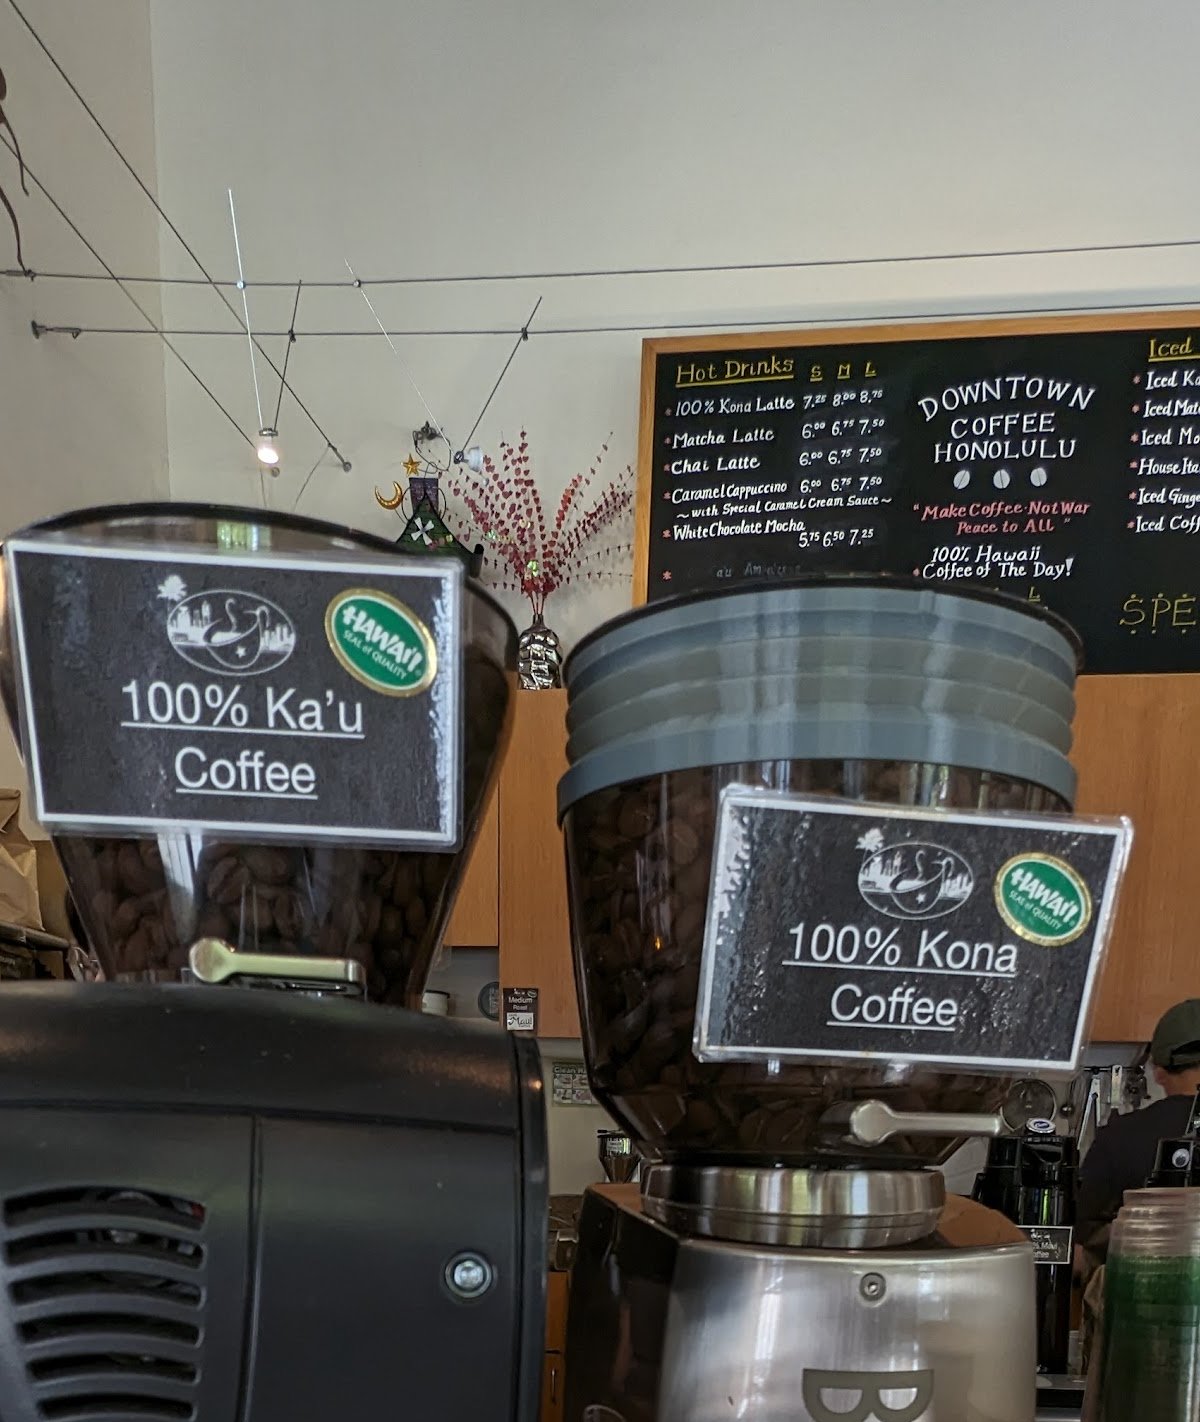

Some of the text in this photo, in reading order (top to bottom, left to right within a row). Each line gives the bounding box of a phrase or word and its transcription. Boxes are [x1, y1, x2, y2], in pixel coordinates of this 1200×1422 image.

[1149, 336, 1192, 358] Iced
[676, 355, 794, 384] Hot Drinks
[810, 361, 876, 377] S M L
[1145, 370, 1178, 391] Iced
[675, 389, 883, 417] 100% Kona Latte 7.25 8.00 8.75
[917, 375, 1096, 422] DOWNTOWN
[1143, 399, 1172, 418] Iced
[672, 418, 885, 449] Matcha Latte 6.00 6.75 7.50
[950, 412, 1056, 439] COFFEE
[1140, 427, 1200, 446] Iced Mo
[671, 447, 882, 474] Chai Latte 6.00 6.75 7.50
[934, 439, 1076, 464] HONOLULU
[1137, 458, 1181, 476] House
[672, 476, 882, 504] Caramel Cappuccino 6.00 6.75 7.50
[1137, 487, 1166, 505] Iced
[691, 495, 879, 519] with Special Caramel Cream Sauce
[1027, 501, 1058, 516] Not
[1060, 502, 1090, 515] War
[672, 518, 874, 548] White Chocolate Mocha 5.75 6.50 7.25
[956, 520, 999, 536] Peace
[1001, 520, 1018, 533] to
[1135, 514, 1165, 533] Iced
[931, 545, 1042, 563] 100% Hawaii
[922, 557, 1075, 581] Coffee of The Day!
[343, 629, 363, 649] SEAL
[371, 651, 407, 679] QUALITY
[121, 679, 364, 734] 100% Ka’u
[174, 746, 317, 794] Coffee
[1008, 890, 1026, 906] SEAL
[1032, 907, 1062, 930] QUALITY
[788, 922, 1018, 973] 100% Kona
[830, 983, 958, 1026] Coffee
